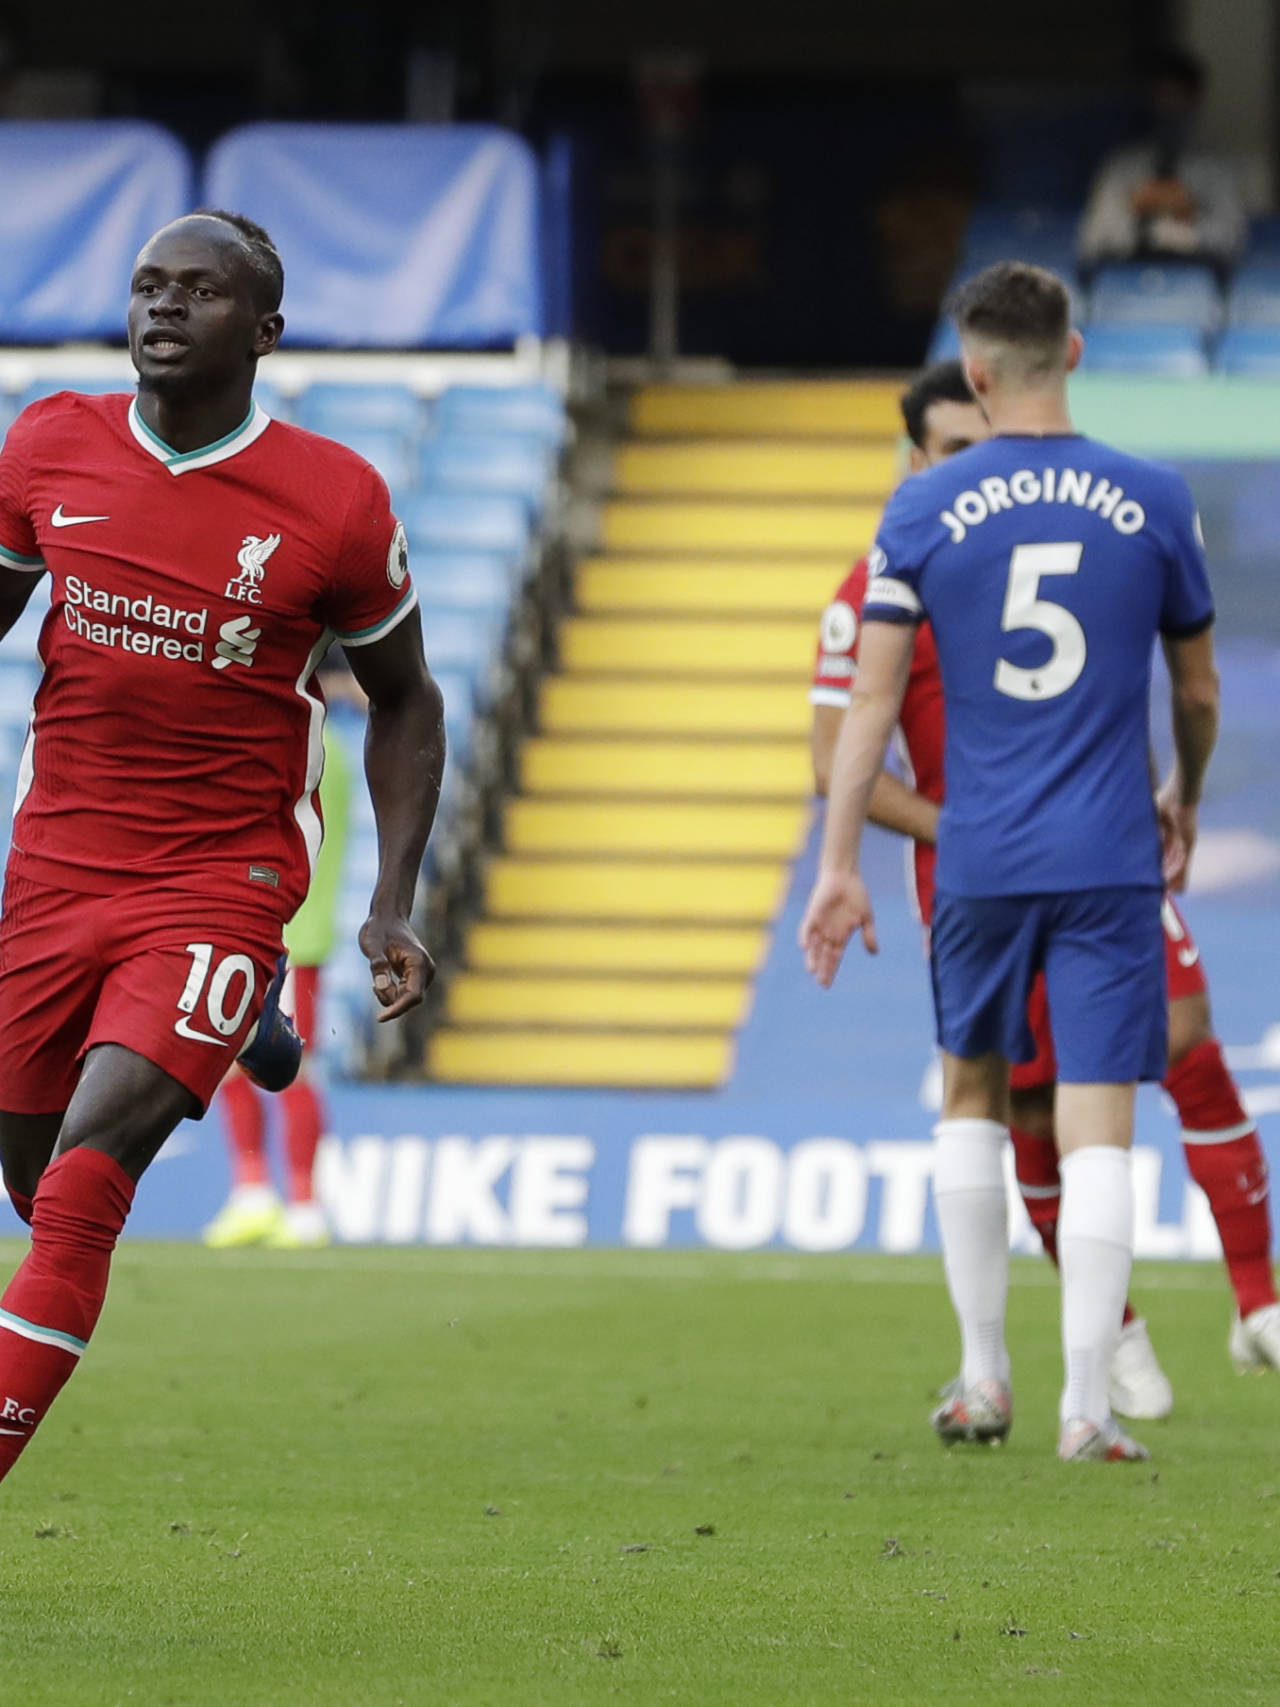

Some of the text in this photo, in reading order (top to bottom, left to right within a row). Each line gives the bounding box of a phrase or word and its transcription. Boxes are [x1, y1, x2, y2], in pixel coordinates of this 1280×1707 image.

[940, 467, 1145, 544] JORGINHO
[64, 602, 203, 662] Chartered
[65, 575, 207, 635] Standard
[993, 541, 1087, 701] 5
[177, 943, 255, 1036] 10
[314, 1133, 1224, 1260] NIKE FOOTL
